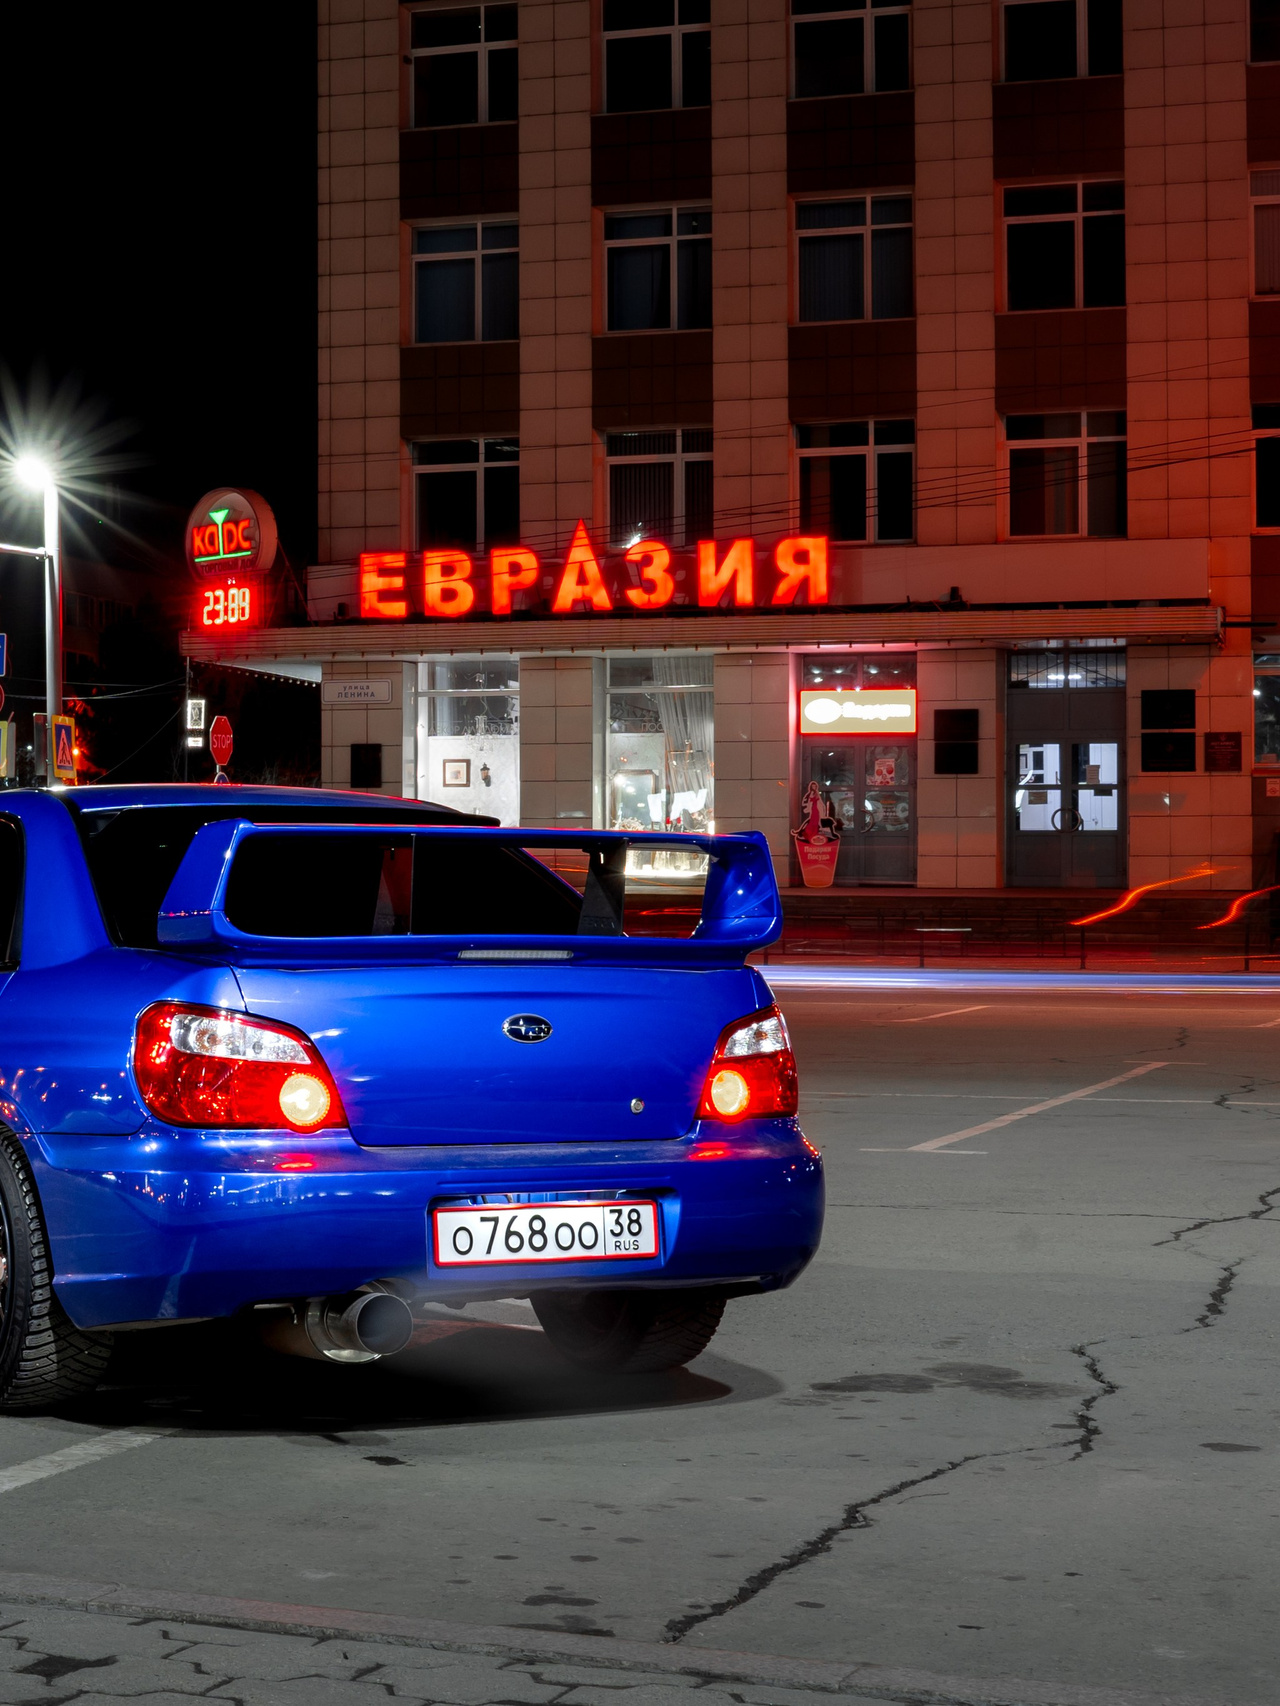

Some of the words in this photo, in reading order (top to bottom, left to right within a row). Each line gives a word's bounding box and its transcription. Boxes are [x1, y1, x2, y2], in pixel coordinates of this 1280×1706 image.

[360, 518, 828, 617] ЕВРАЗИЯ
[213, 734, 230, 748] STOP
[609, 1208, 642, 1237] 38
[615, 1239, 640, 1251] RUS
